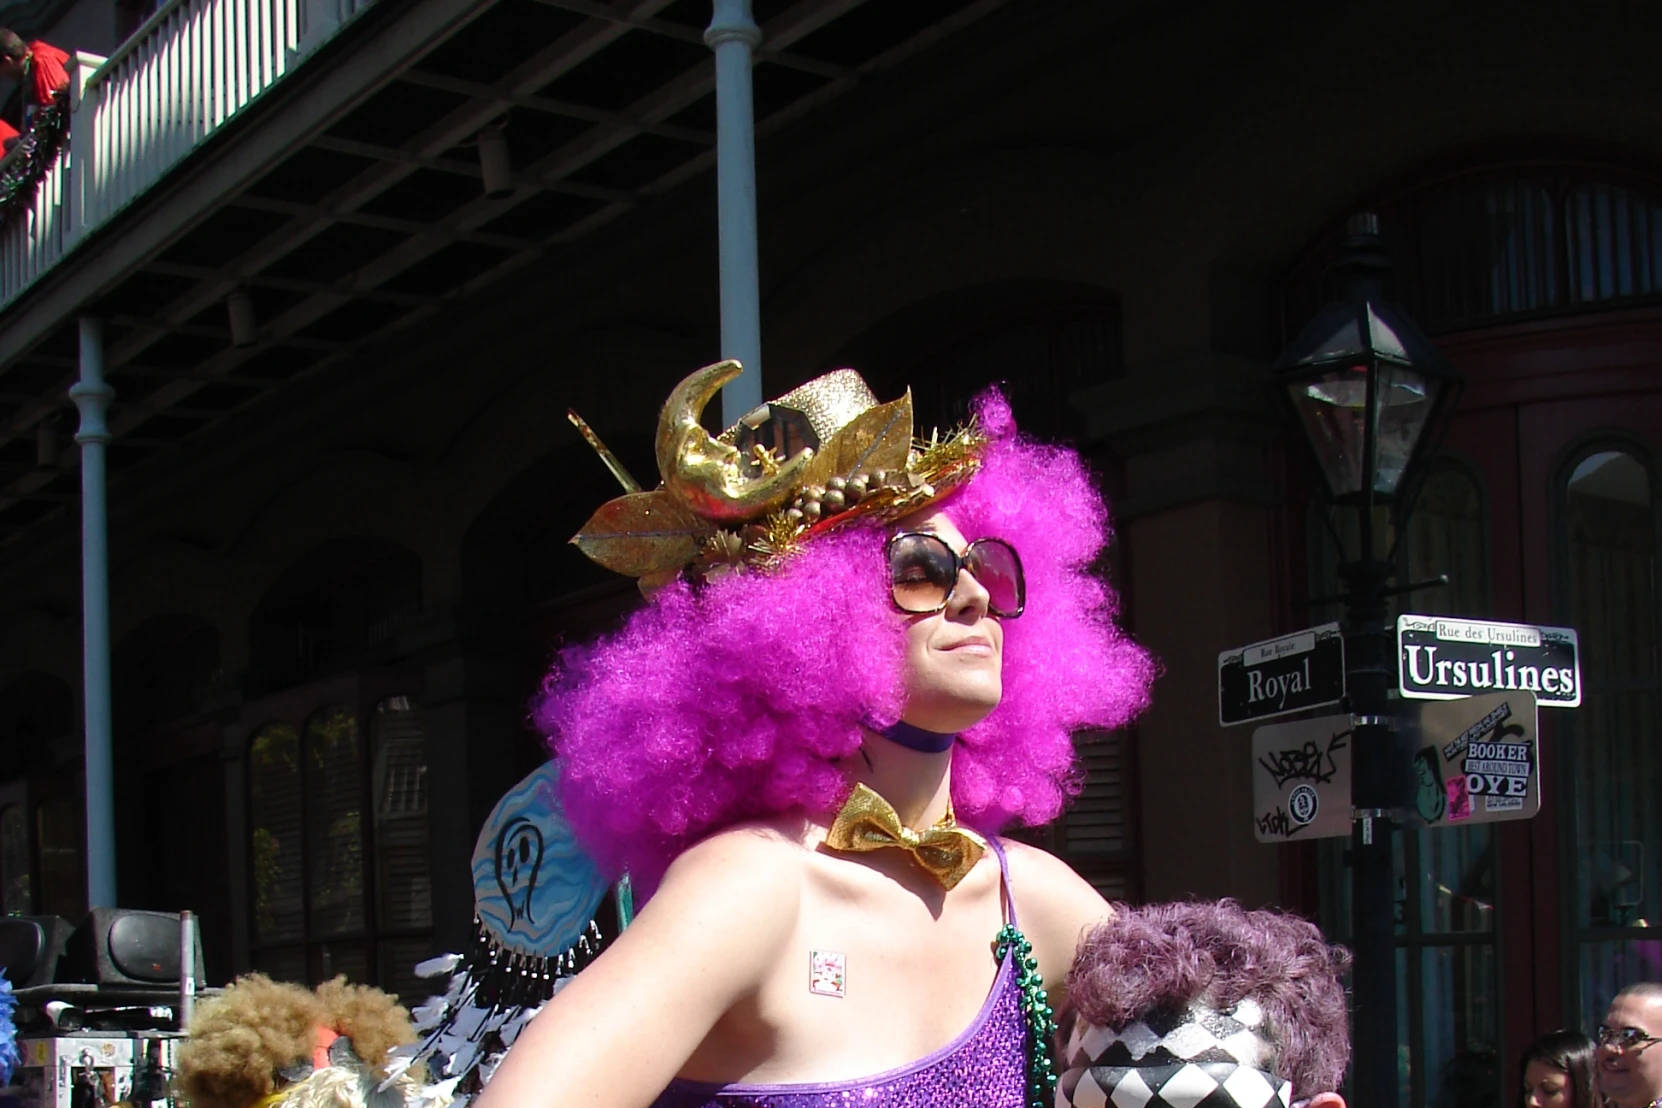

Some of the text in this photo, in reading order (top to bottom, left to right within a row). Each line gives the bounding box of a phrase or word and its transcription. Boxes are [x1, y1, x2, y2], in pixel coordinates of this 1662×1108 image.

[1438, 623, 1538, 644] Rue des Ursulines
[1404, 645, 1574, 694] Ursulines
[1247, 656, 1312, 710] Royal
[1468, 743, 1528, 761] BOOKER
[1482, 761, 1507, 773] AROUND
[1508, 763, 1527, 775] TOWN
[1467, 774, 1528, 796] OYE
